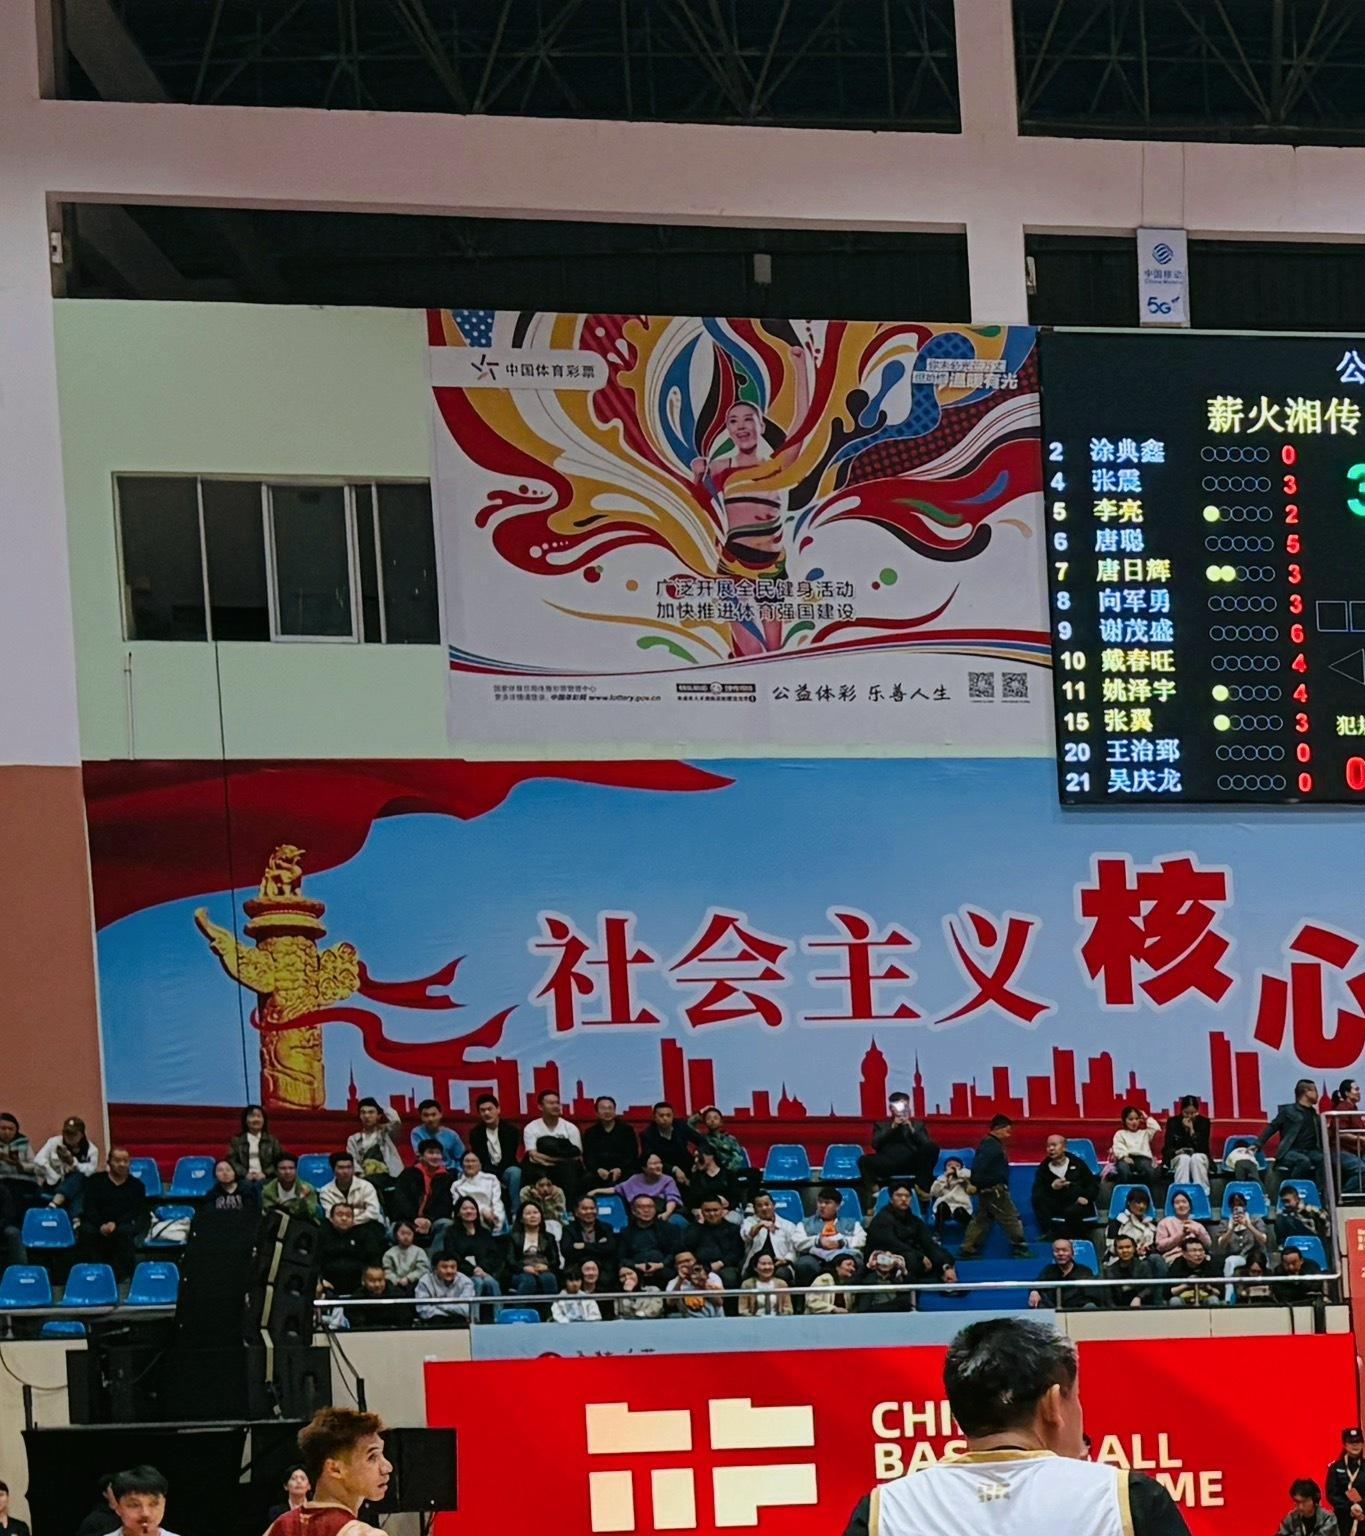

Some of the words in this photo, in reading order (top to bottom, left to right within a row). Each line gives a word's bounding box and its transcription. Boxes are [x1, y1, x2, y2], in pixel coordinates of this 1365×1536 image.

[1147, 296, 1171, 314] 5G
[504, 364, 596, 380] 中国体育彩票
[1206, 395, 1362, 436] 薪火湘传
[1048, 441, 1064, 462] 2
[1281, 445, 1298, 467] 0
[1050, 471, 1066, 492] 4
[1091, 467, 1143, 494] 张震
[1284, 475, 1299, 496] 3
[1052, 501, 1067, 522] 5
[1285, 504, 1300, 525] 2
[1053, 531, 1069, 552] 6
[1094, 527, 1145, 553] 唐聪
[1285, 534, 1302, 555] 5
[1054, 561, 1069, 581] 7
[1096, 557, 1172, 583] 唐日辉
[1289, 563, 1303, 586] 3
[655, 579, 855, 600] 广泛开展全民健身活动
[1056, 591, 1072, 611] 8
[1098, 587, 1171, 614] 向军勇
[1290, 594, 1305, 616] 3
[655, 601, 856, 622] 加快推进体育强国建设
[1057, 620, 1073, 641] 9
[1098, 617, 1175, 644] 谢茂盛
[1289, 623, 1307, 645] 6
[1060, 651, 1085, 671] 10
[1100, 647, 1176, 673] 戴春旺
[1291, 654, 1309, 674] 4
[772, 684, 858, 702] 公益体彩
[867, 684, 952, 702] 乐善人生
[1061, 680, 1085, 701] 11
[1101, 677, 1177, 703] 姚泽宇
[1292, 685, 1309, 705] 4
[1063, 712, 1089, 732] 15
[1103, 707, 1154, 733] 张翼
[1296, 713, 1310, 734] 3
[1064, 742, 1090, 762] 20
[1296, 742, 1313, 764] 0
[1065, 772, 1090, 792] 21
[1107, 766, 1183, 794] 吴庆龙
[1297, 772, 1314, 794] 0
[872, 1400, 962, 1438] CHI
[874, 1433, 1182, 1479] BASALL
